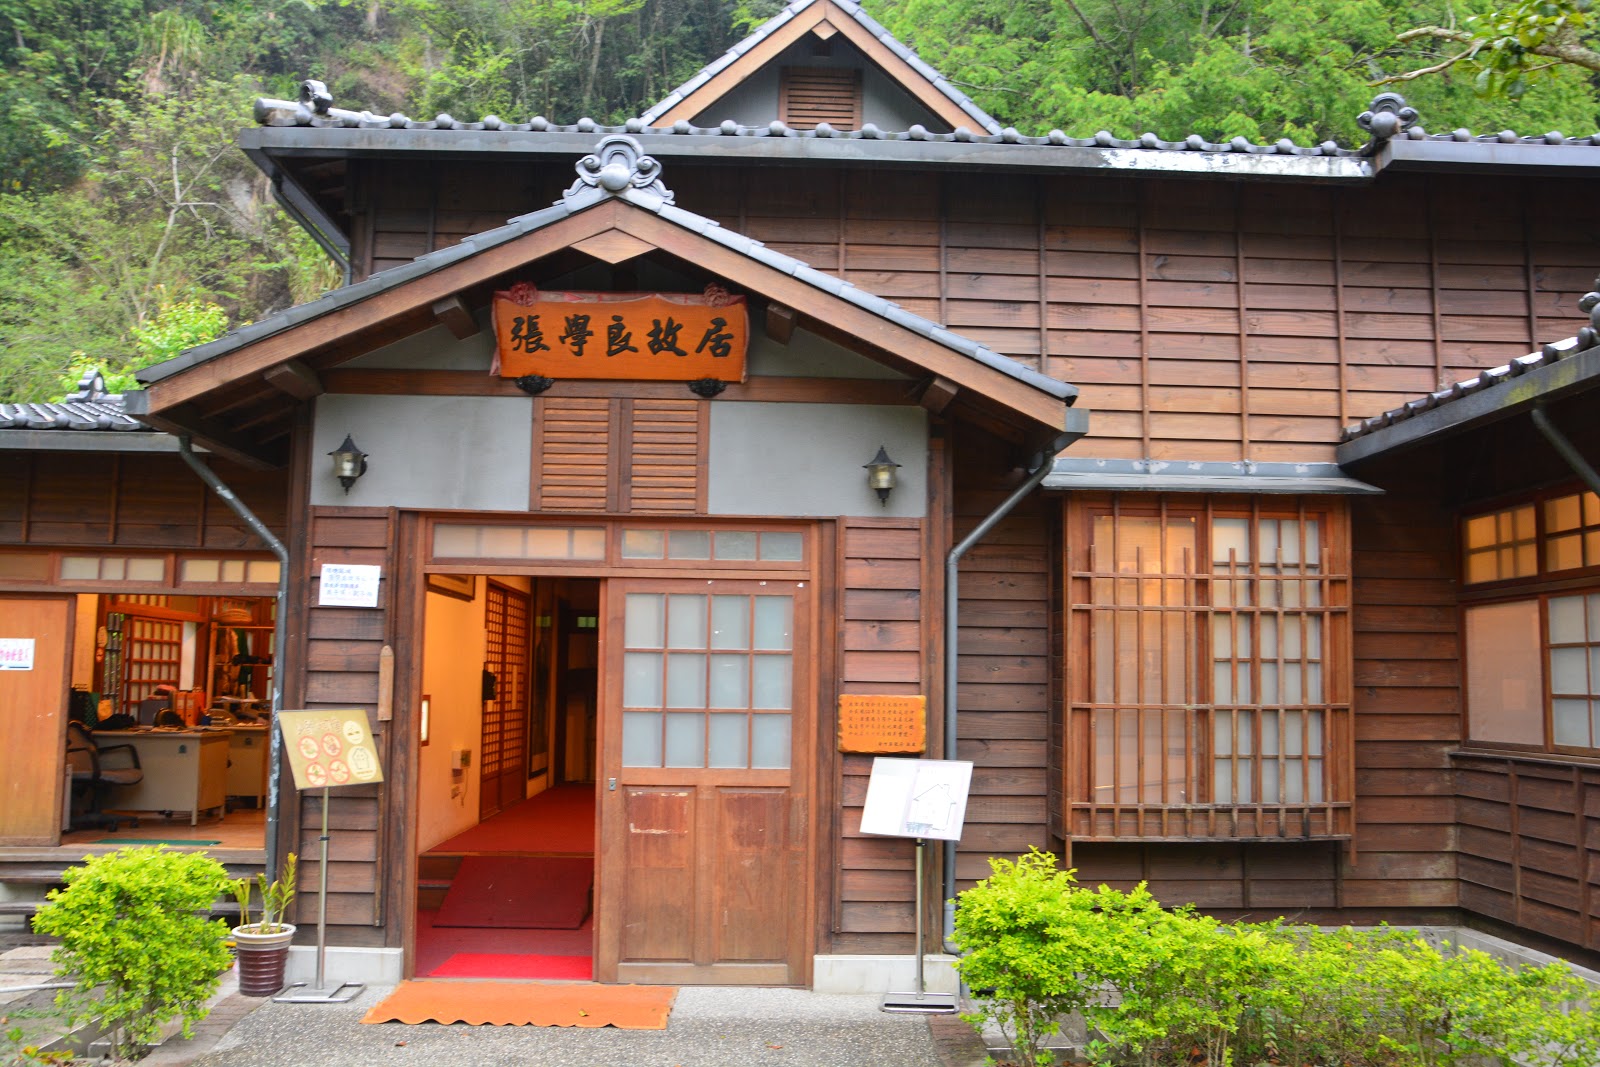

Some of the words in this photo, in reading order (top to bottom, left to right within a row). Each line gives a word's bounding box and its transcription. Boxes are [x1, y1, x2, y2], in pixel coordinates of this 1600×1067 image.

[510, 314, 734, 357] 張學良故居
